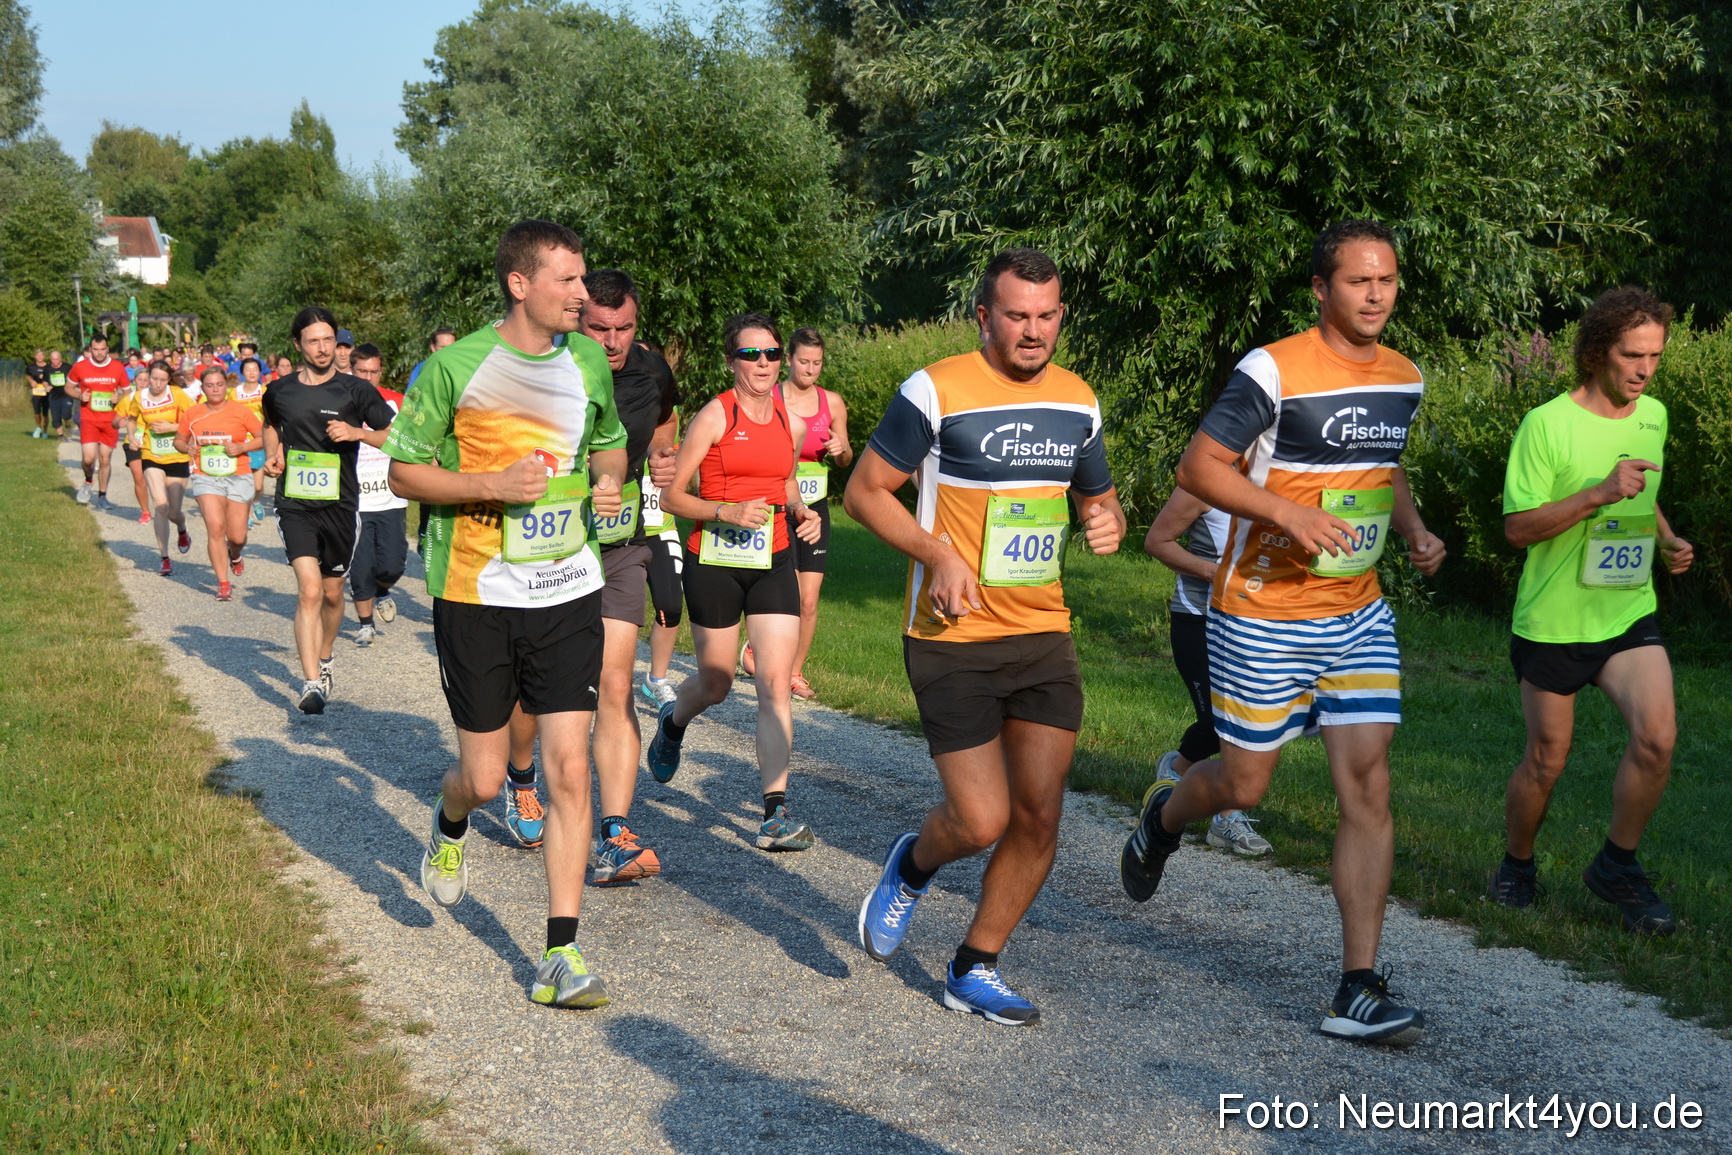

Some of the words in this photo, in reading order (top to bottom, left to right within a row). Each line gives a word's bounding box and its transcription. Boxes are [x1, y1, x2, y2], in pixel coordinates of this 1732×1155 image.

[1341, 421, 1408, 442] Fischer
[1001, 437, 1077, 457] Fischer
[1345, 441, 1404, 451] AUTOMOBILE
[207, 457, 229, 469] 613
[1009, 458, 1073, 467] AUTOMOBILE
[297, 470, 329, 487] 103
[521, 509, 573, 541] 987
[710, 527, 767, 552] 1396
[1003, 534, 1055, 563] 408
[1598, 545, 1643, 570] 263
[1019, 567, 1047, 575] Krauberger
